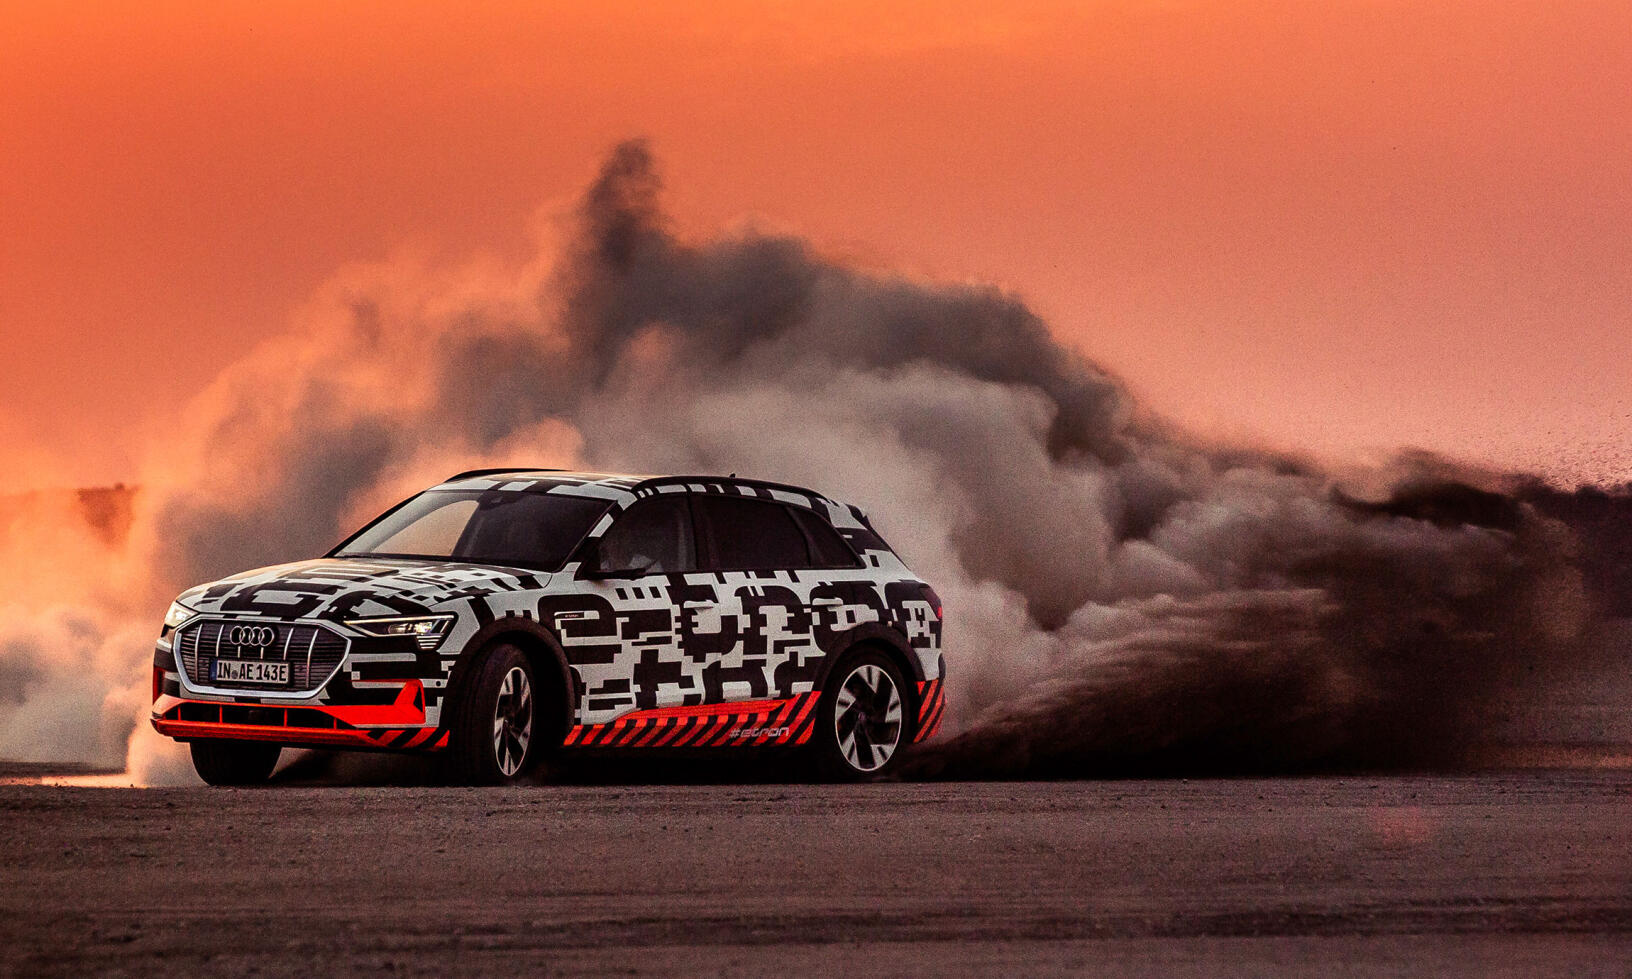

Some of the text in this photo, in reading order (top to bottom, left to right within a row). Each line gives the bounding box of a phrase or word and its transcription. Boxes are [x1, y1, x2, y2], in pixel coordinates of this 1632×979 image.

[218, 662, 286, 681] IN AE 143E
